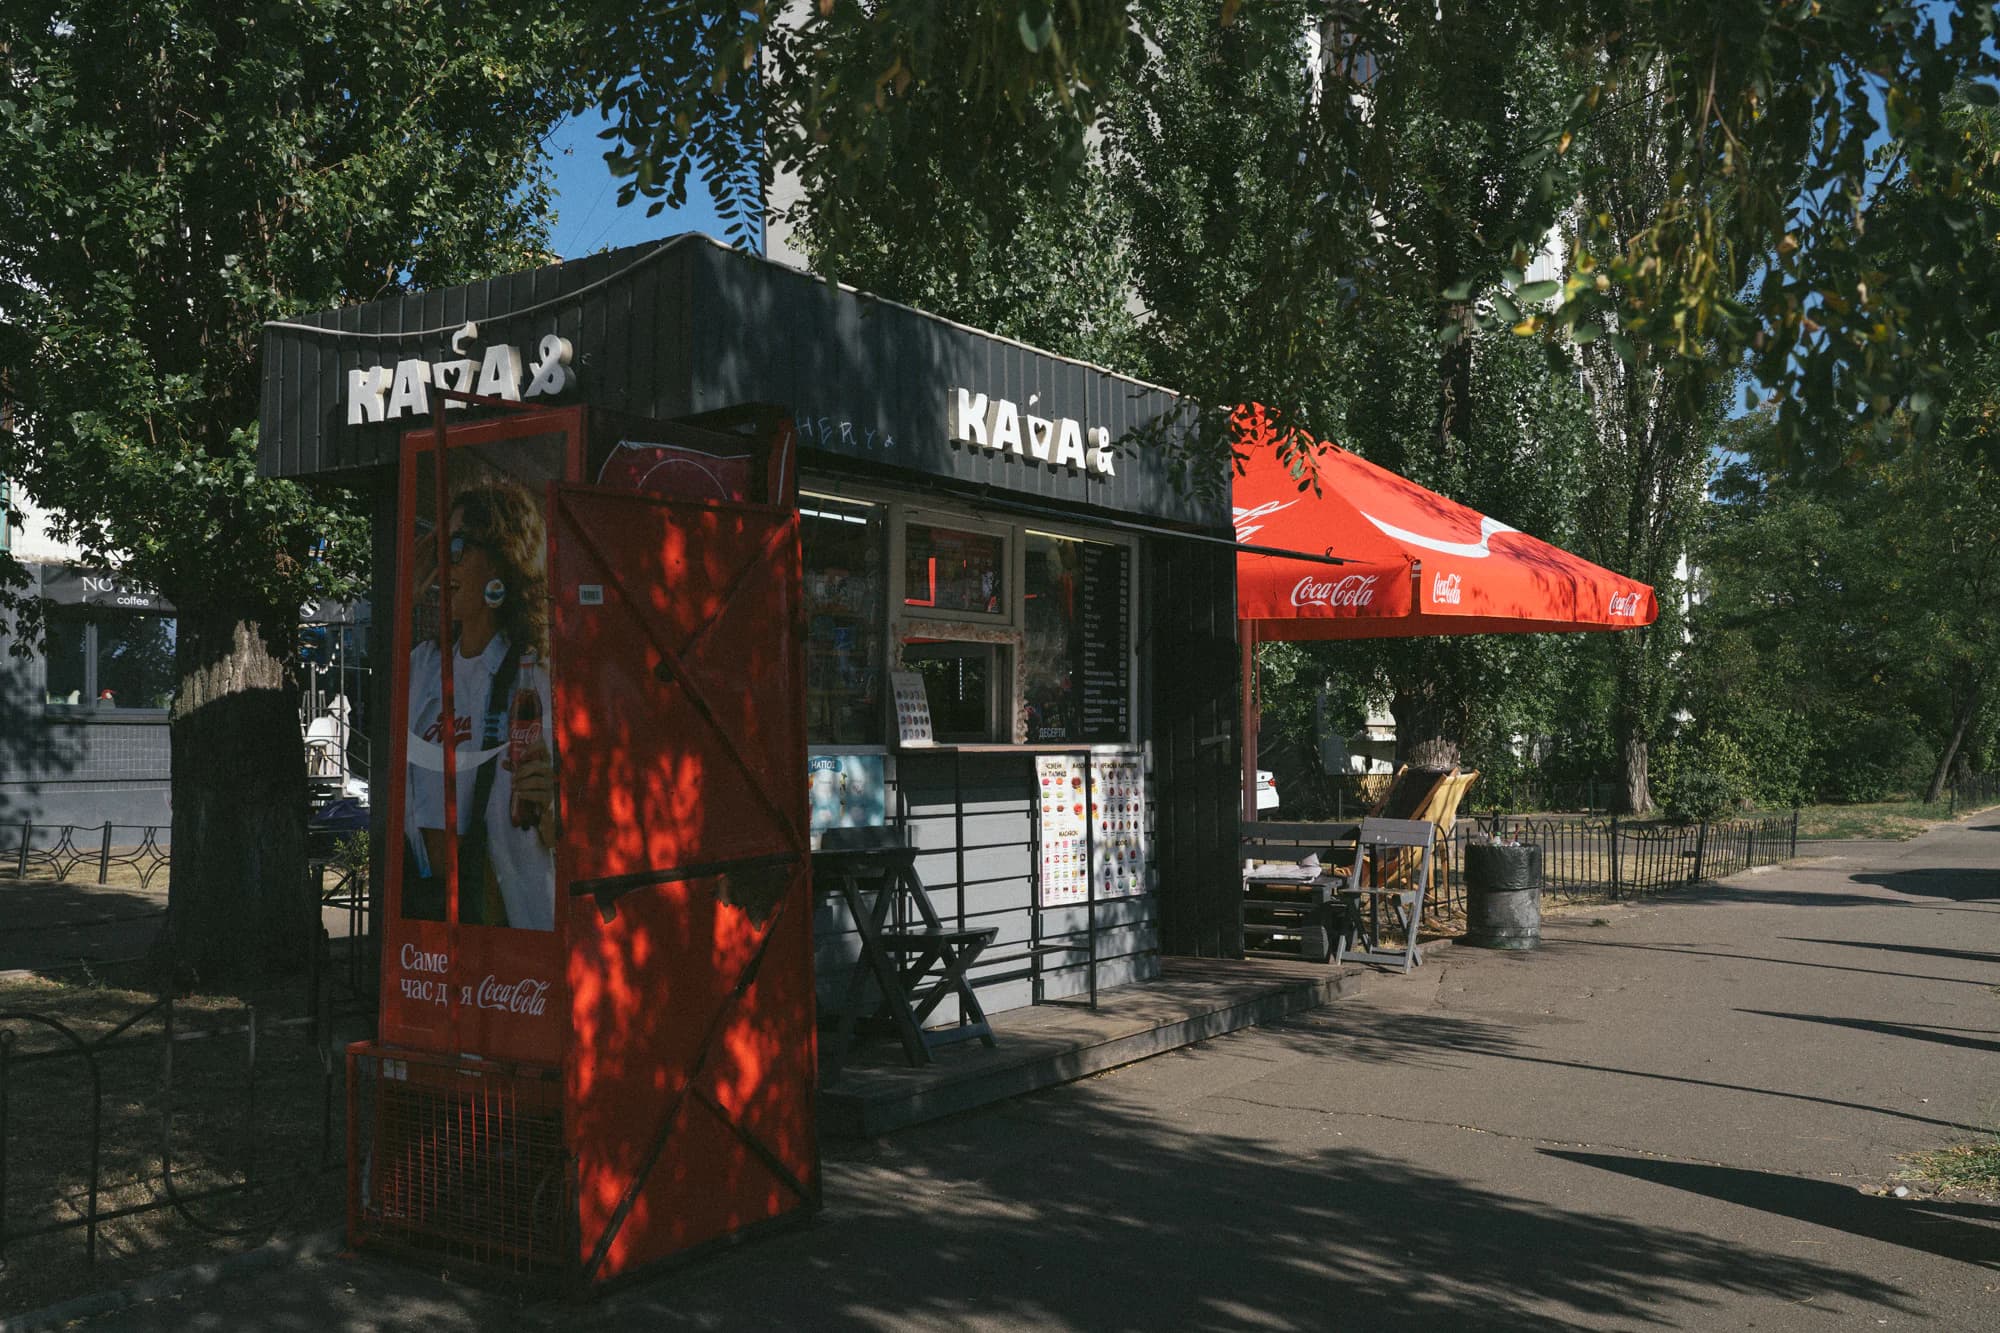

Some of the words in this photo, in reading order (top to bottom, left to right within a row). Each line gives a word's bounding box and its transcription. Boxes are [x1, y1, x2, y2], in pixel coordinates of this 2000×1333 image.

[117, 596, 149, 606] coffee
[1291, 574, 1379, 607] Coca-Cola
[1433, 571, 1462, 605] Coca-Cola
[400, 943, 448, 974] Саме
[400, 978, 433, 1001] час
[435, 983, 473, 1009] дя
[477, 974, 551, 1016] Coca-Cola
